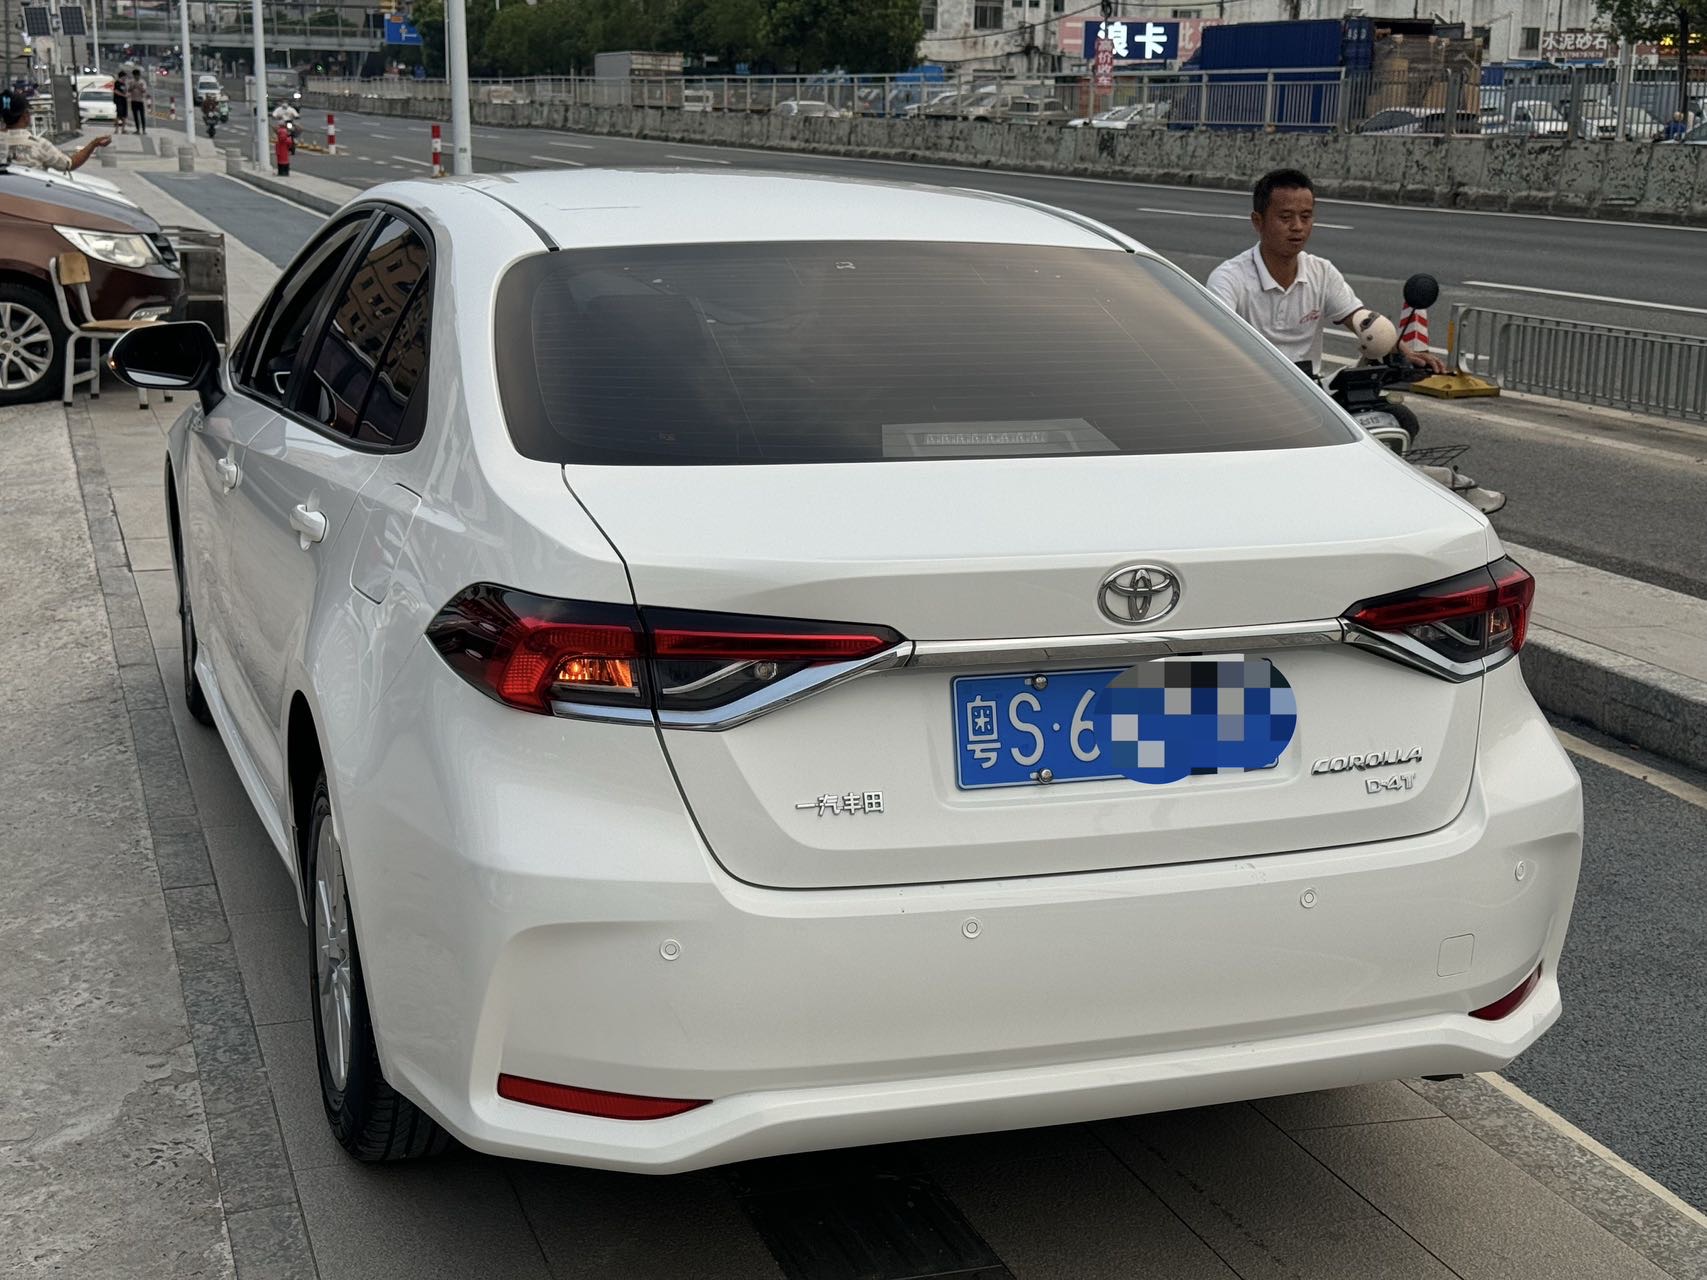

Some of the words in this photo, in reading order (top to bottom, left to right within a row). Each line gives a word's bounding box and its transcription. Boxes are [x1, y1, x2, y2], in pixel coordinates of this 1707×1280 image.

[1542, 32, 1608, 50] 水泥砂石
[1311, 745, 1423, 776] COROLLA
[1365, 773, 1416, 794] D-4T
[795, 791, 884, 817] 一汽丰田
